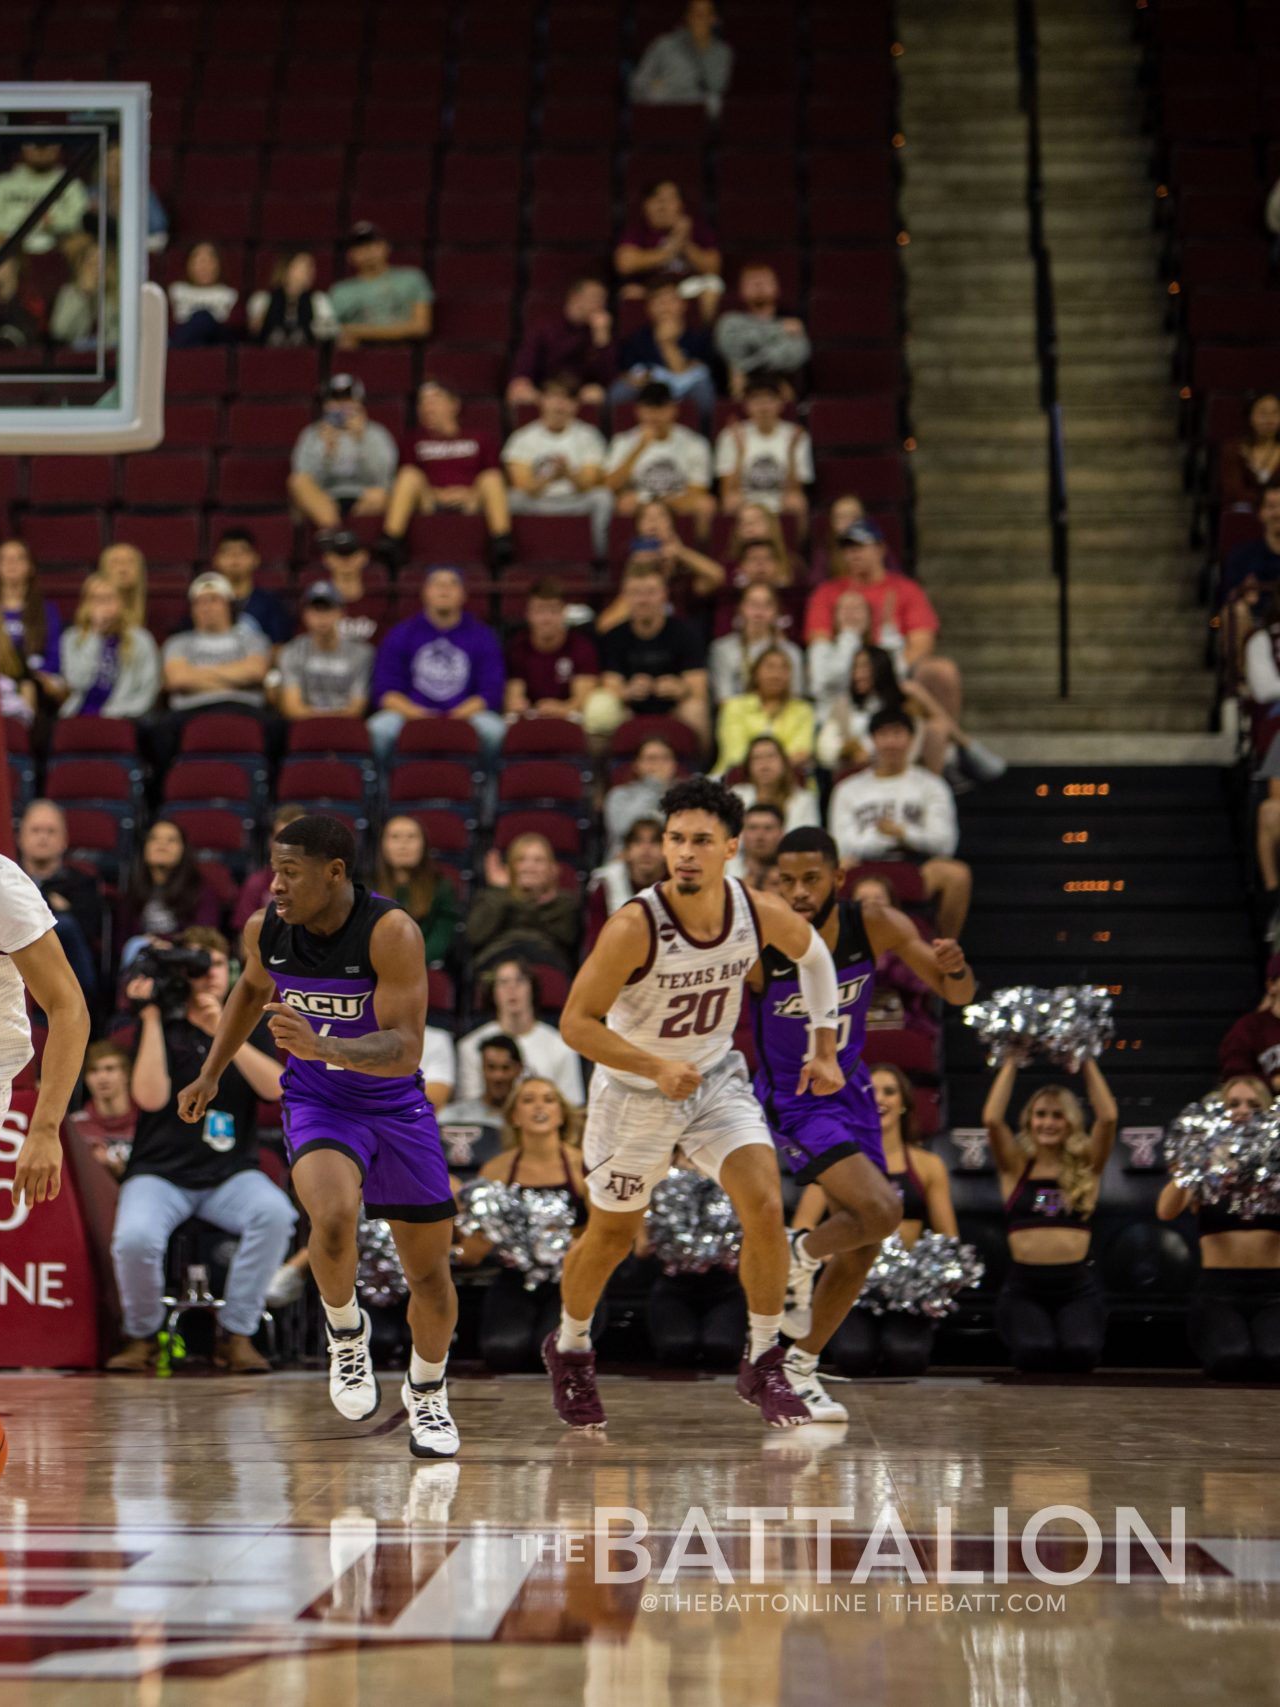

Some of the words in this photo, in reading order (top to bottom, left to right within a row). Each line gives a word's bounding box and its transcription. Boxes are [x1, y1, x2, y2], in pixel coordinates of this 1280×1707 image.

[657, 967, 715, 989] TEXAS
[720, 957, 751, 980] A&M
[283, 990, 365, 1019] ACU
[658, 986, 731, 1038] 20
[774, 974, 870, 1019] AU
